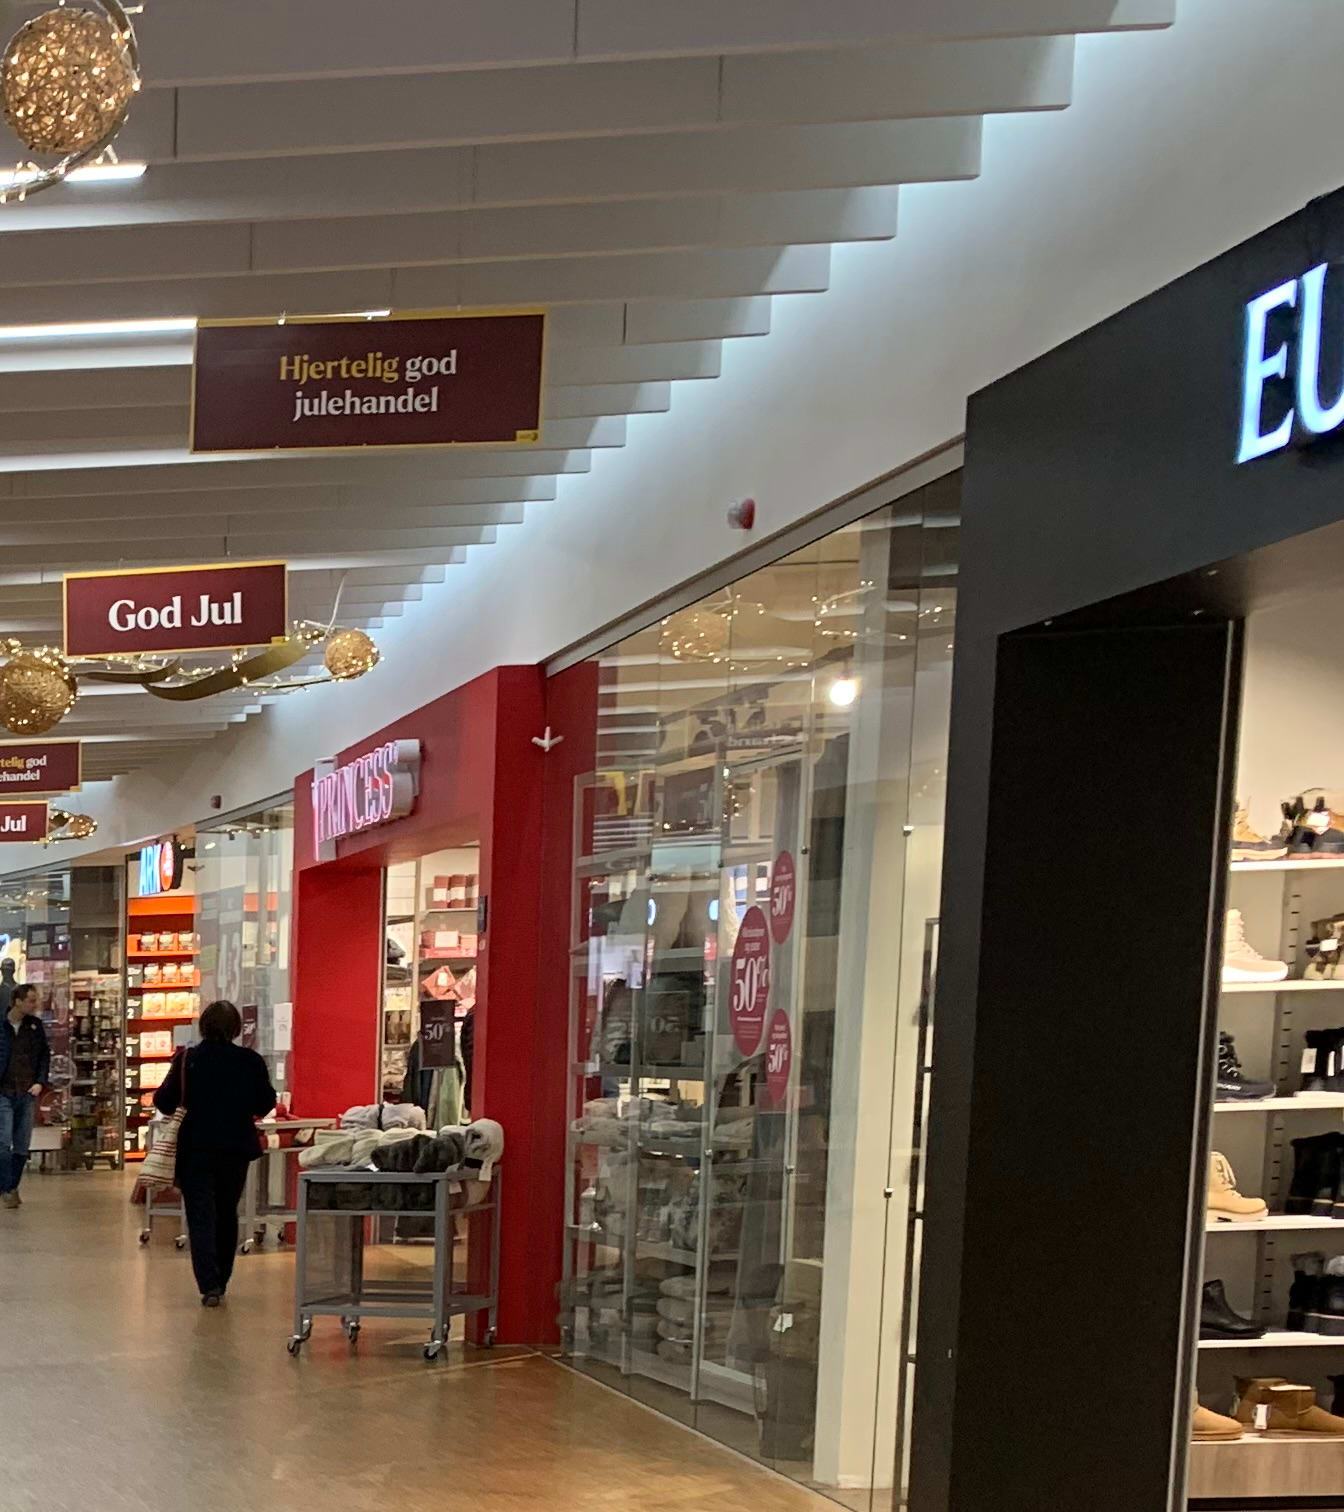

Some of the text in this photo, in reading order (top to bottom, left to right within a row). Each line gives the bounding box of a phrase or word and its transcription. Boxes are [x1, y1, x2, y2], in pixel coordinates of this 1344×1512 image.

[279, 349, 457, 385] Hjertelig god
[293, 386, 438, 421] julehandel
[108, 592, 242, 632] God Jul
[26, 755, 47, 769] god
[0, 815, 27, 832] Jul
